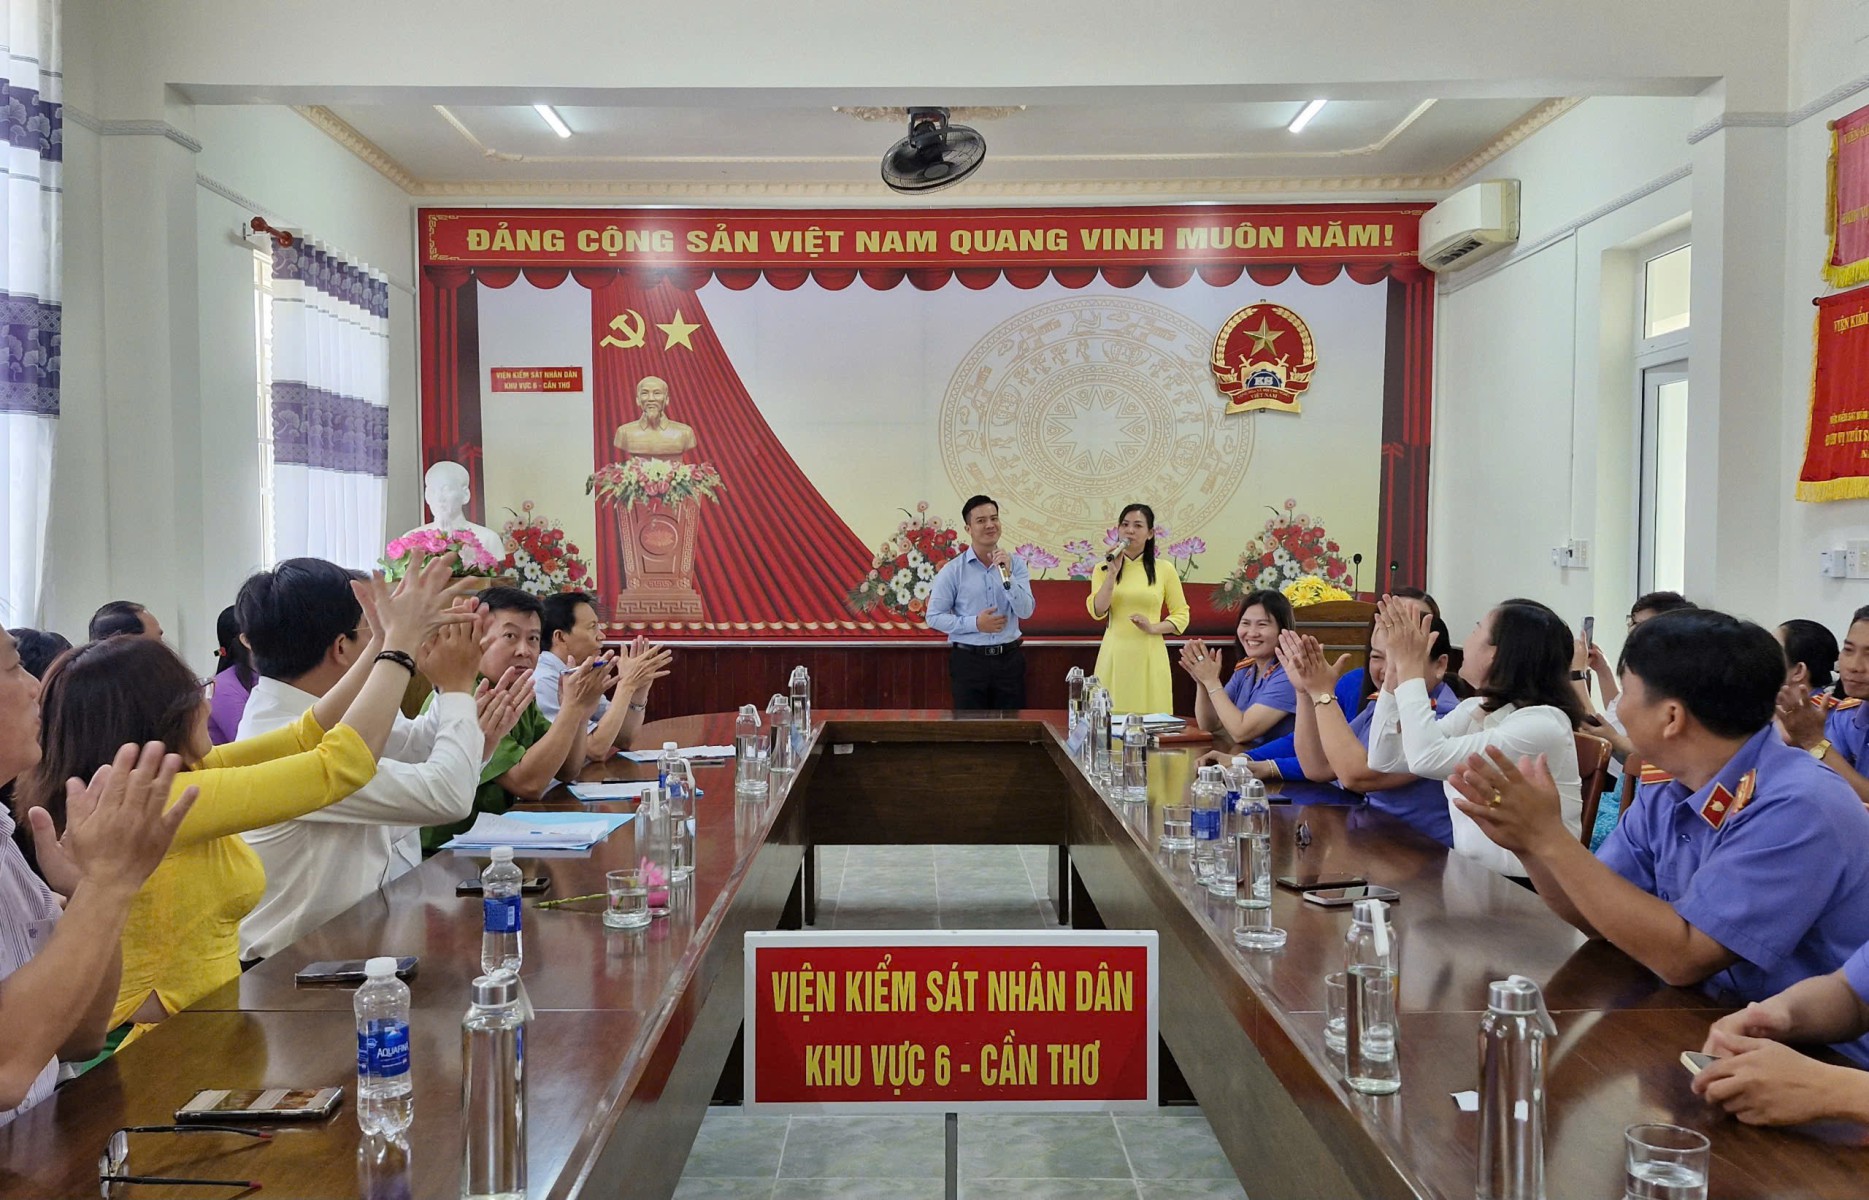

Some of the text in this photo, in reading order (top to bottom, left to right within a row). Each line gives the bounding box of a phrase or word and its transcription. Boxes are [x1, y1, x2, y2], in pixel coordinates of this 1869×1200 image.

[467, 220, 1394, 258] ĐẢNG CỘNG SẢN VIỆT NAM QUANG VINH MUÔN NĂM!
[1253, 376, 1274, 386] KS
[771, 953, 1133, 1022] VIỆN KIỂM SÁT NHÂN DÂN
[805, 1029, 1101, 1096] KHU VỰC 6 - CẦN THƠ
